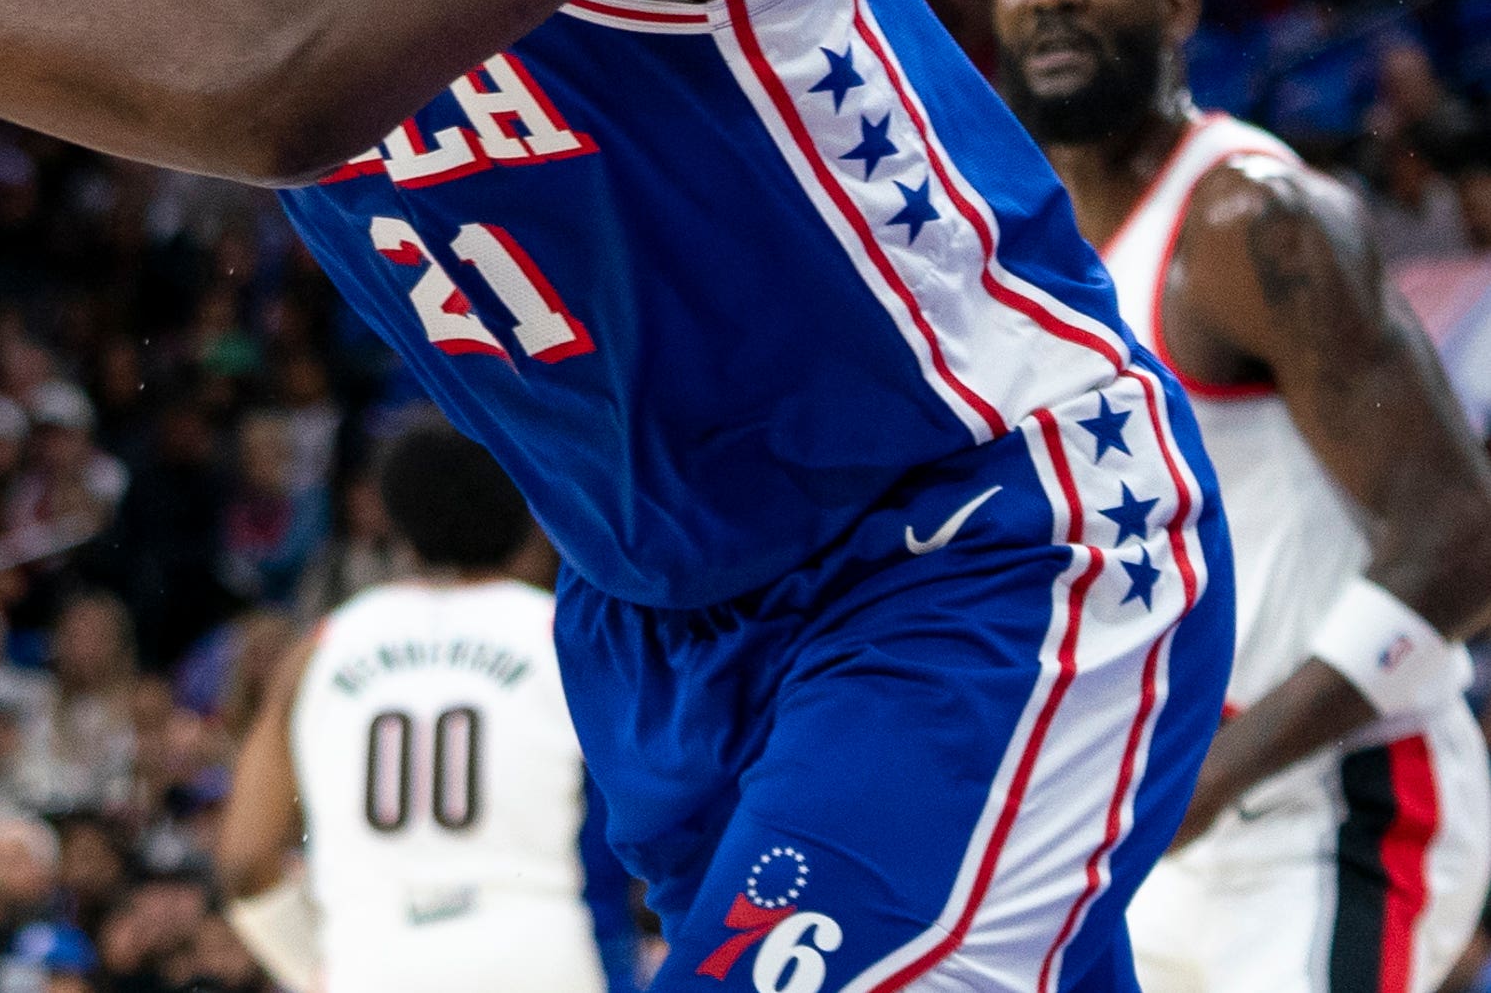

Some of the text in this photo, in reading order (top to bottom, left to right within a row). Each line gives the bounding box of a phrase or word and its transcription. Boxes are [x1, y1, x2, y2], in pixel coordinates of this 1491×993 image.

[369, 216, 597, 365] 21
[365, 705, 480, 833] 00
[695, 892, 844, 993] 76
